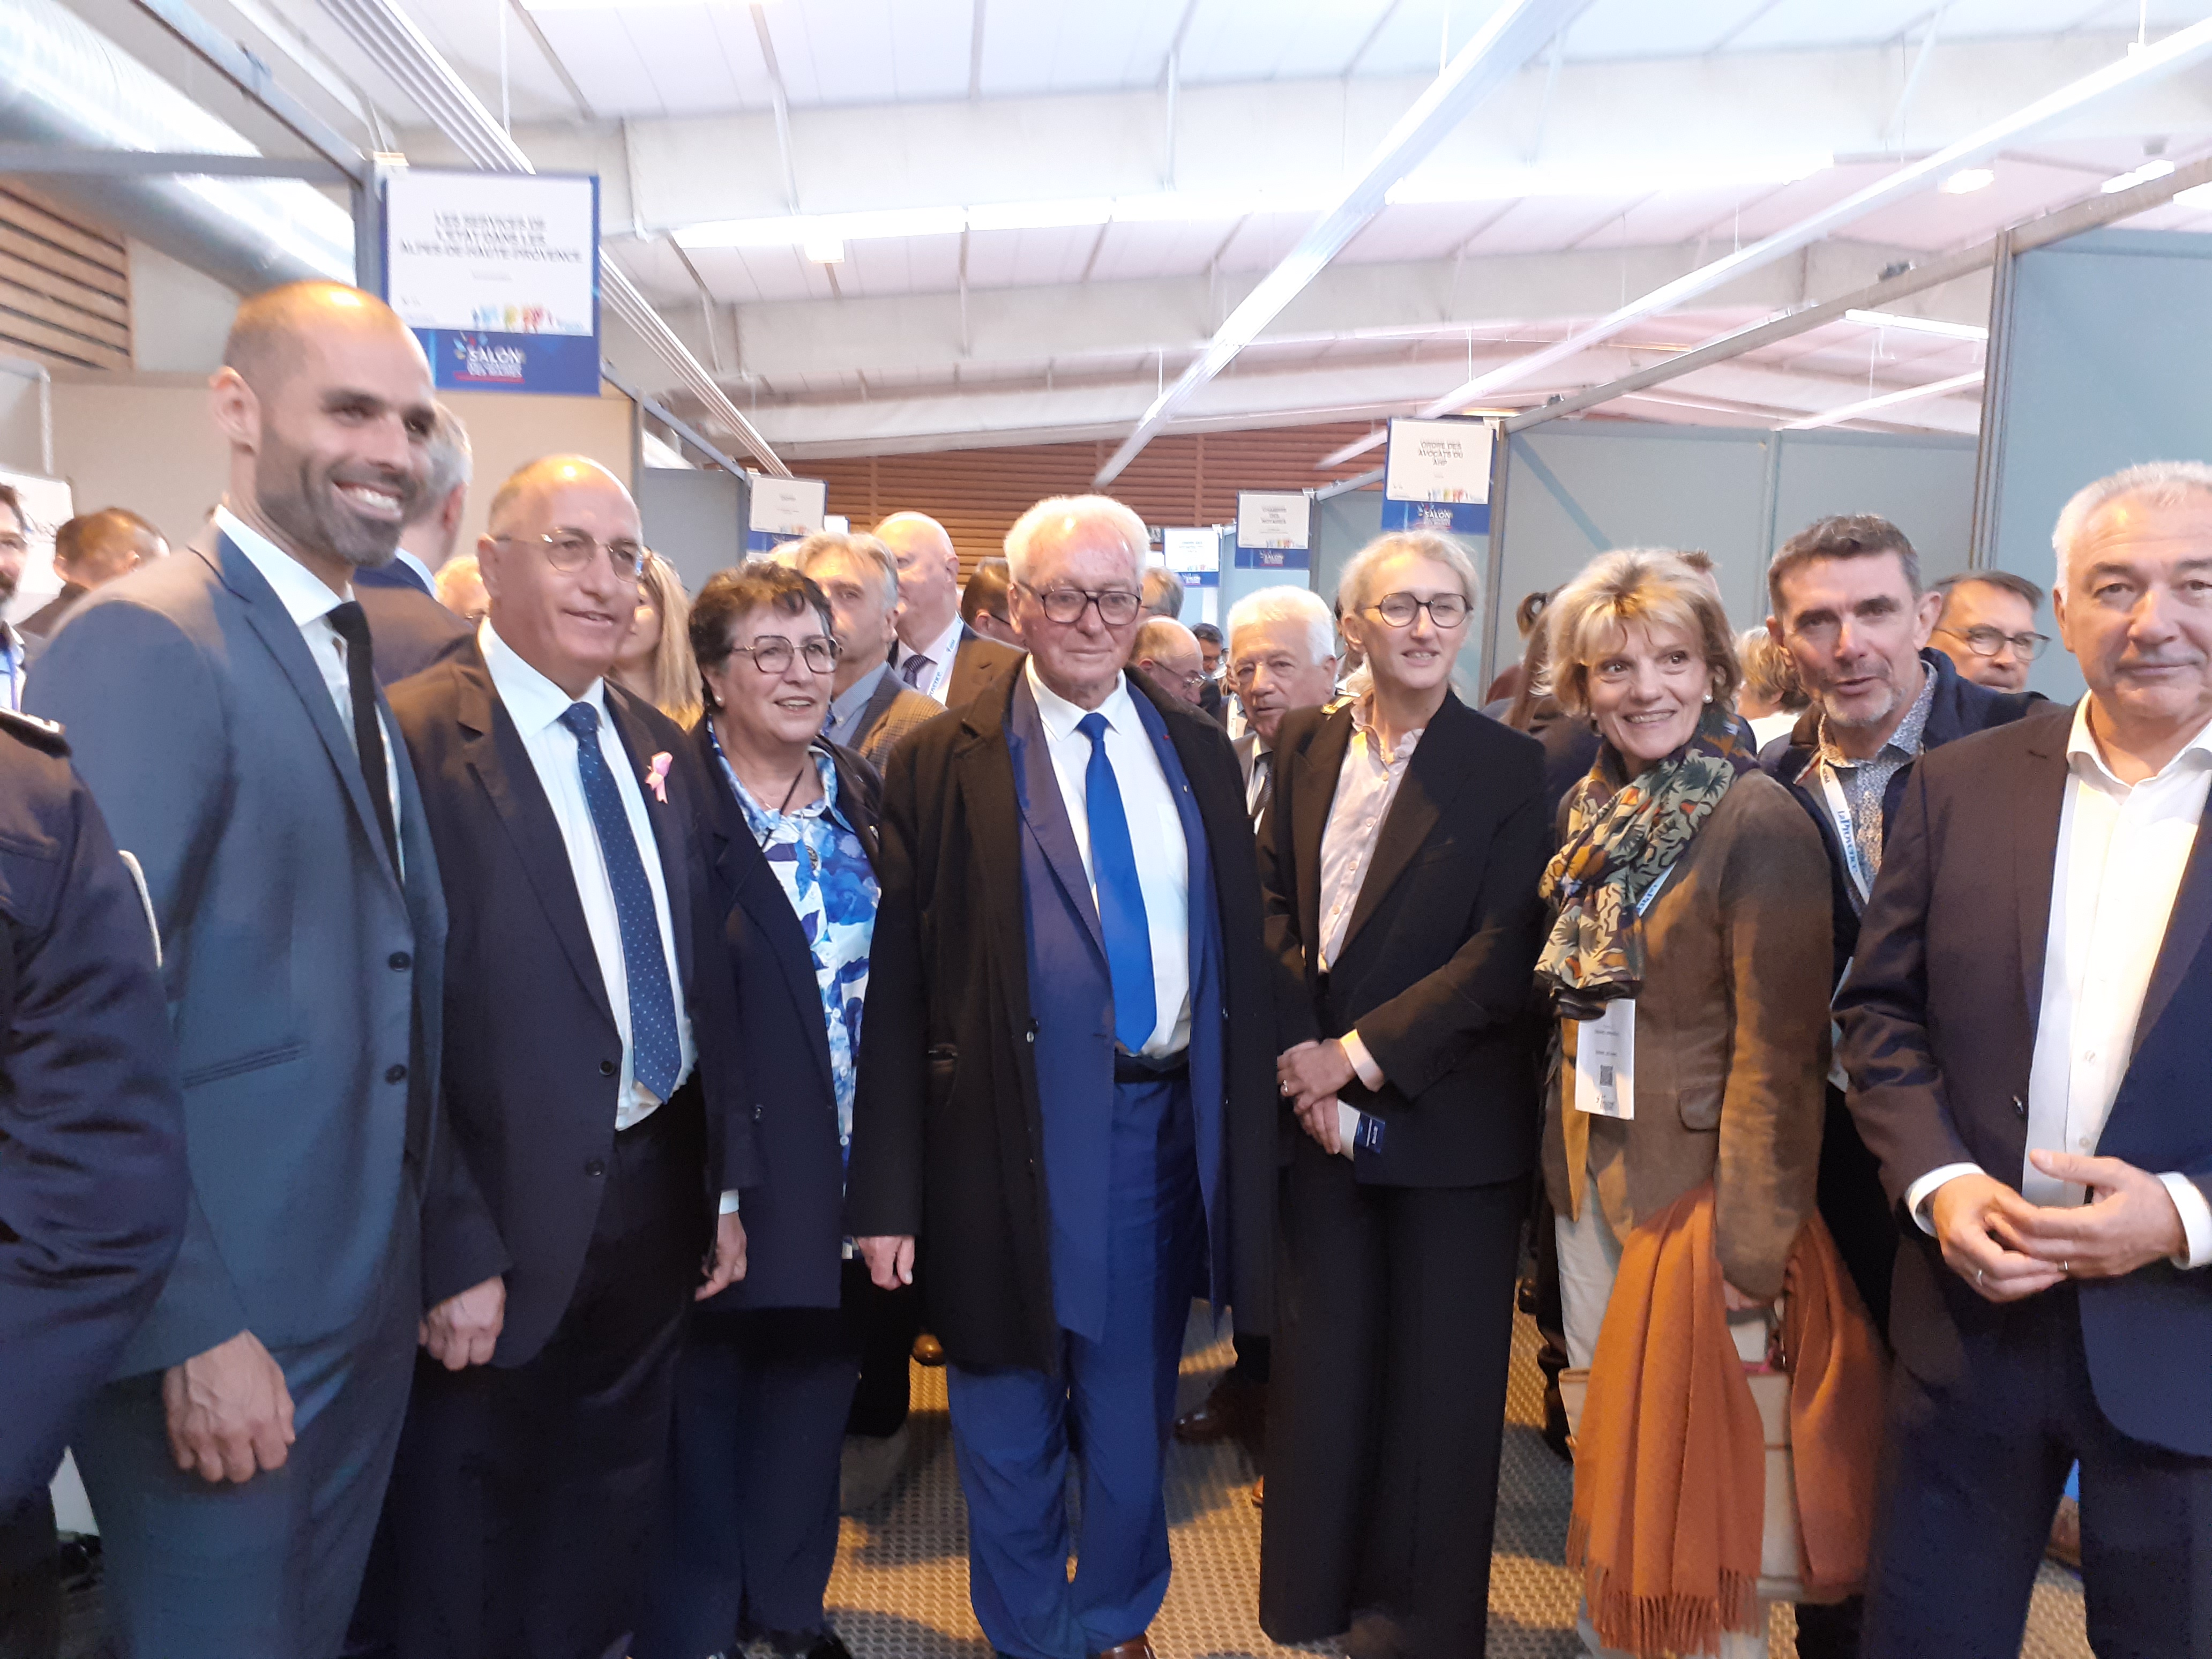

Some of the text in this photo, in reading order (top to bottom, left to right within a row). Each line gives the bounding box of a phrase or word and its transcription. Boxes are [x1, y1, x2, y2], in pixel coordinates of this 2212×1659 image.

[466, 346, 522, 365] SALON
[1418, 449, 1452, 458] AVOCATS
[1424, 511, 1452, 519] SALON
